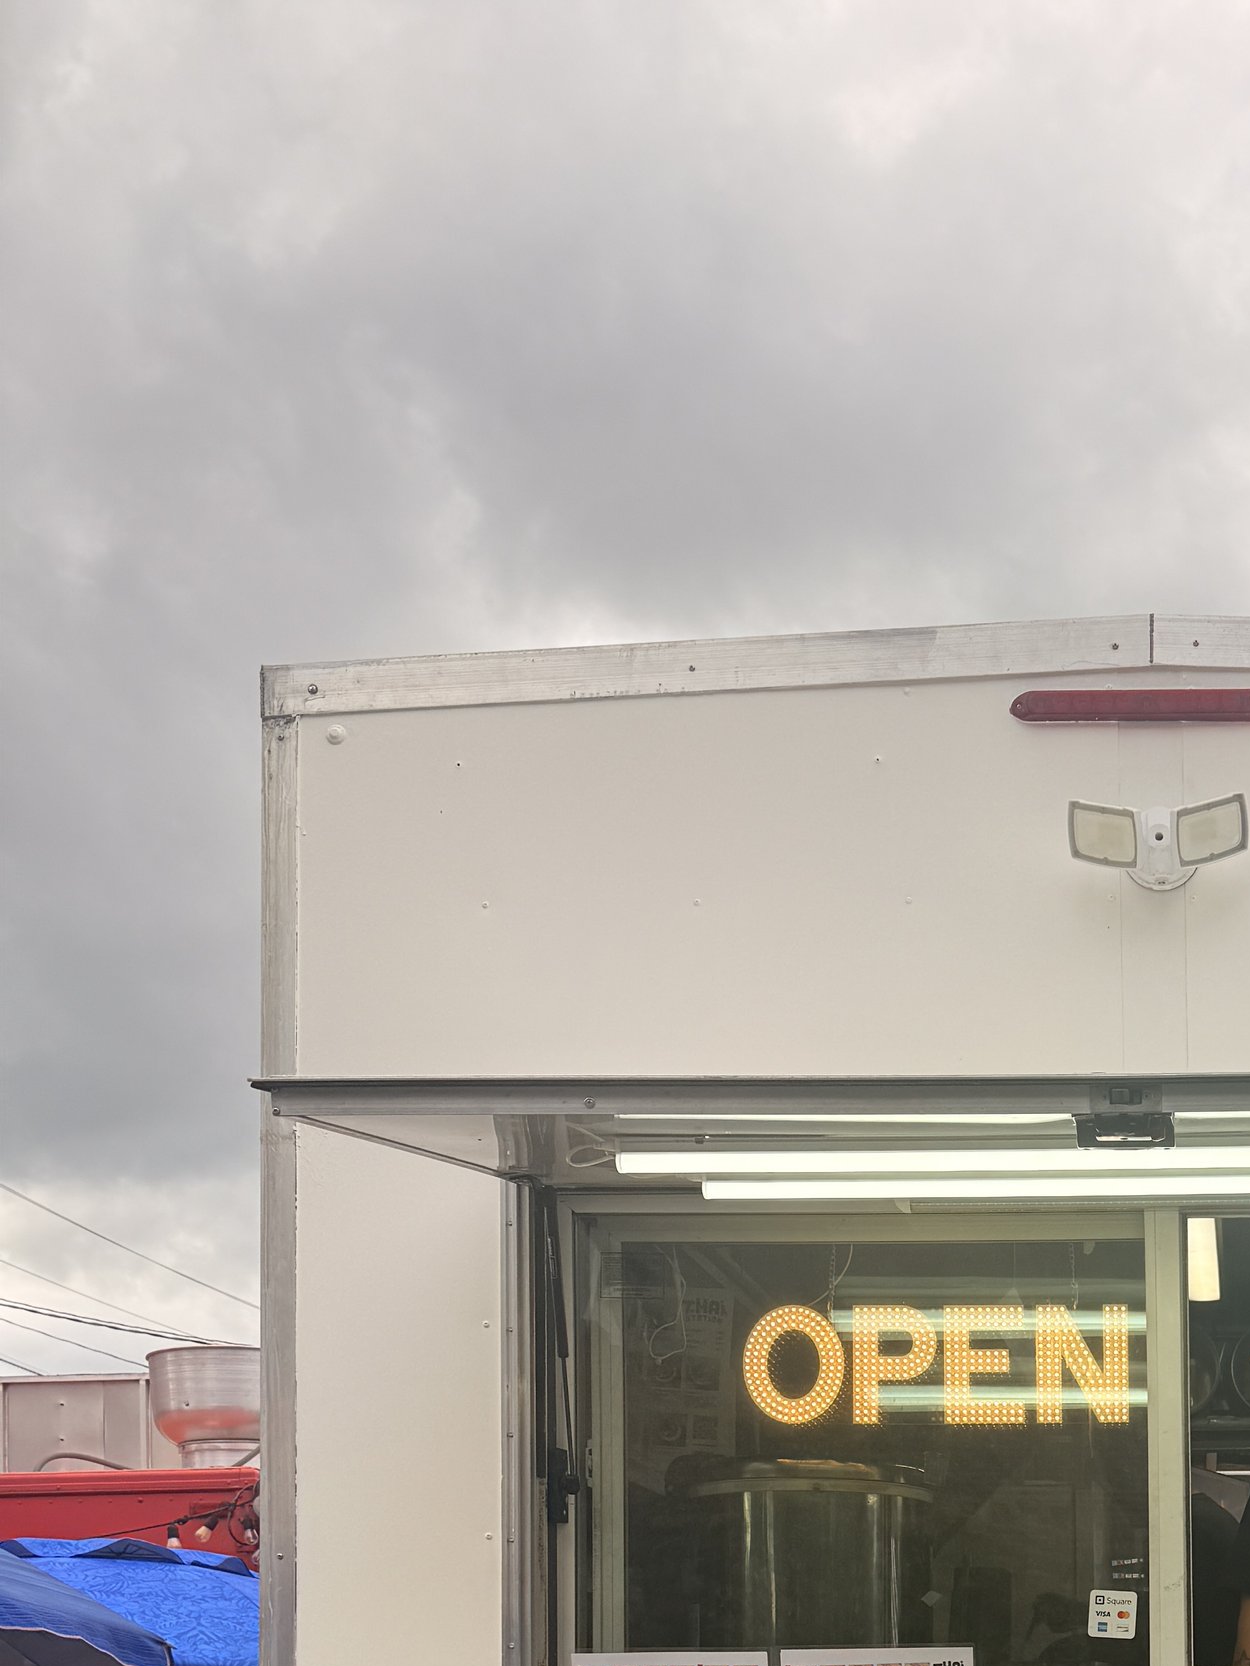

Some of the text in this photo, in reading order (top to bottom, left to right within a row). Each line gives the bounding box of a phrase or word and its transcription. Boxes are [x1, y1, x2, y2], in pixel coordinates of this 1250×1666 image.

[742, 1303, 1130, 1425] OPEN
[1106, 1596, 1133, 1607] Square
[1095, 1610, 1112, 1618] VISA
